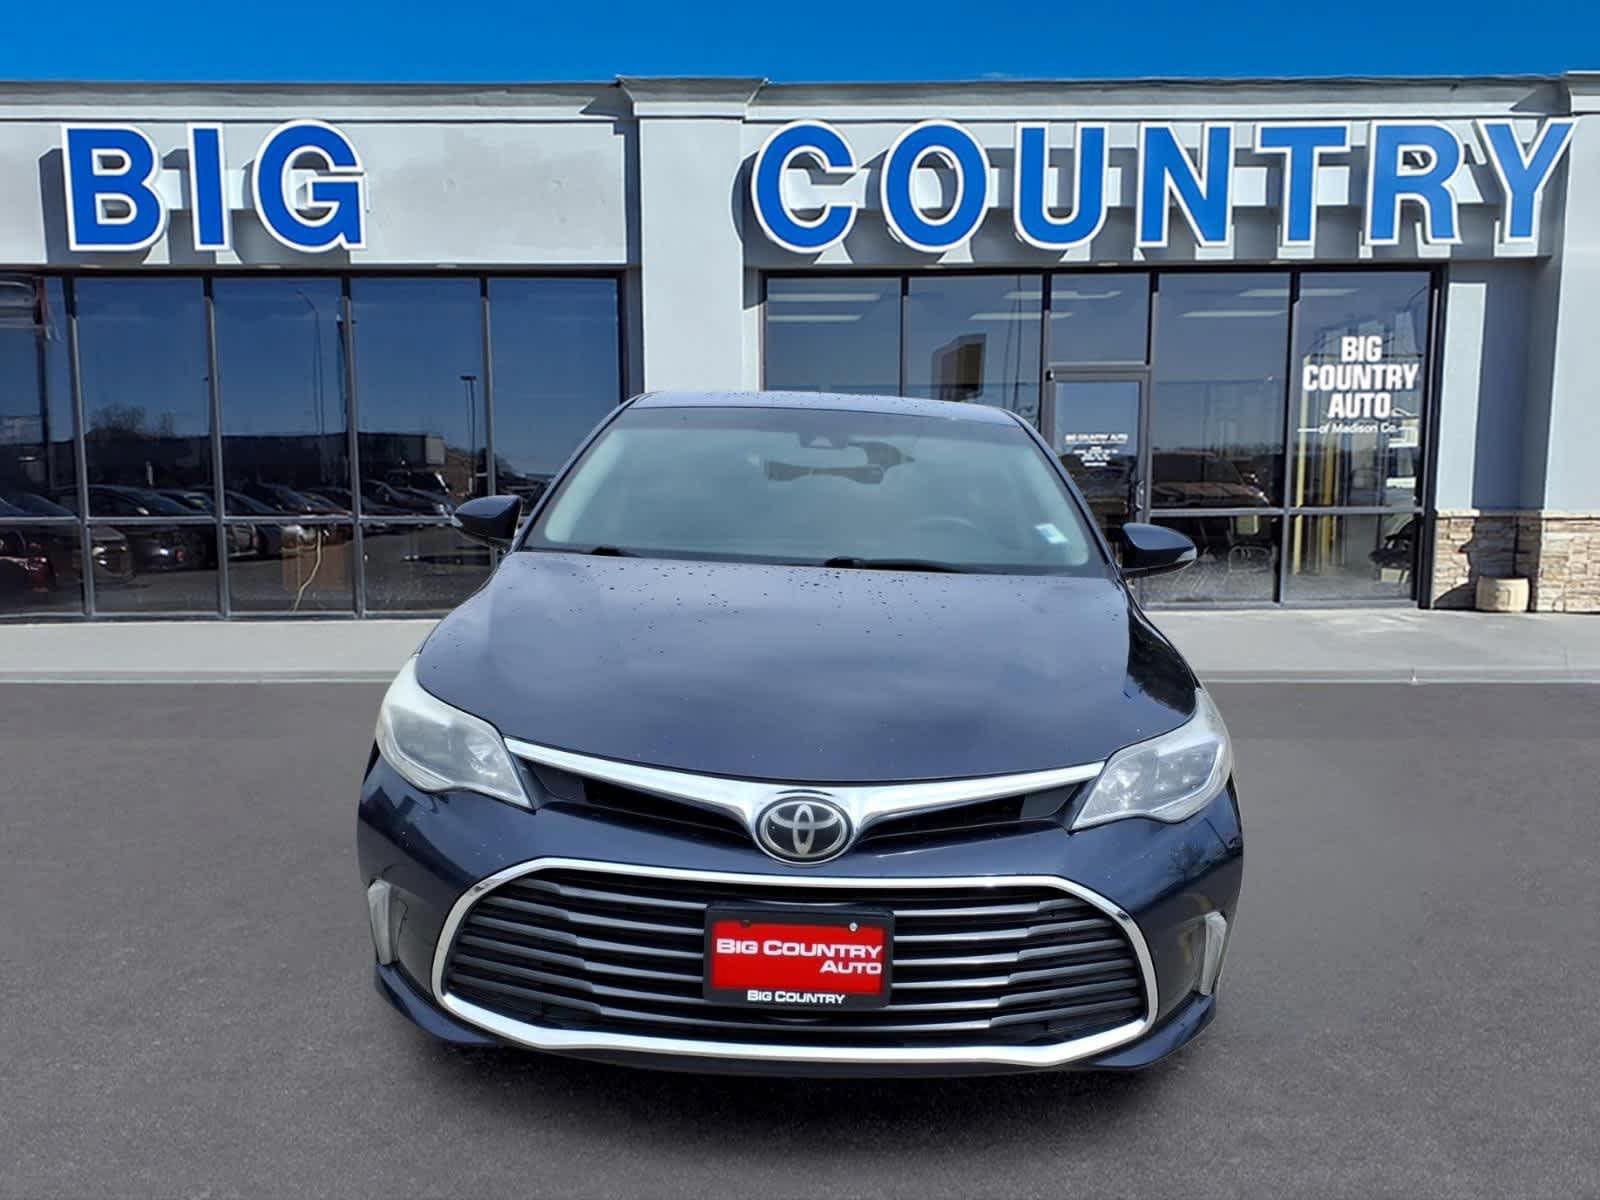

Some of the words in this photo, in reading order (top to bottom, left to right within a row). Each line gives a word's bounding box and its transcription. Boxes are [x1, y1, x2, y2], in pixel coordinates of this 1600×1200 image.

[61, 119, 367, 252] BIG
[750, 118, 1576, 255] COUNTRY
[1341, 336, 1382, 362] BIG
[1303, 364, 1419, 391] COUNTRY
[1328, 393, 1391, 418] AUTO
[716, 938, 758, 954] BIG
[763, 940, 882, 958] COUNTRY
[819, 960, 882, 974] AUTO
[774, 991, 845, 1004] COUNTRY
